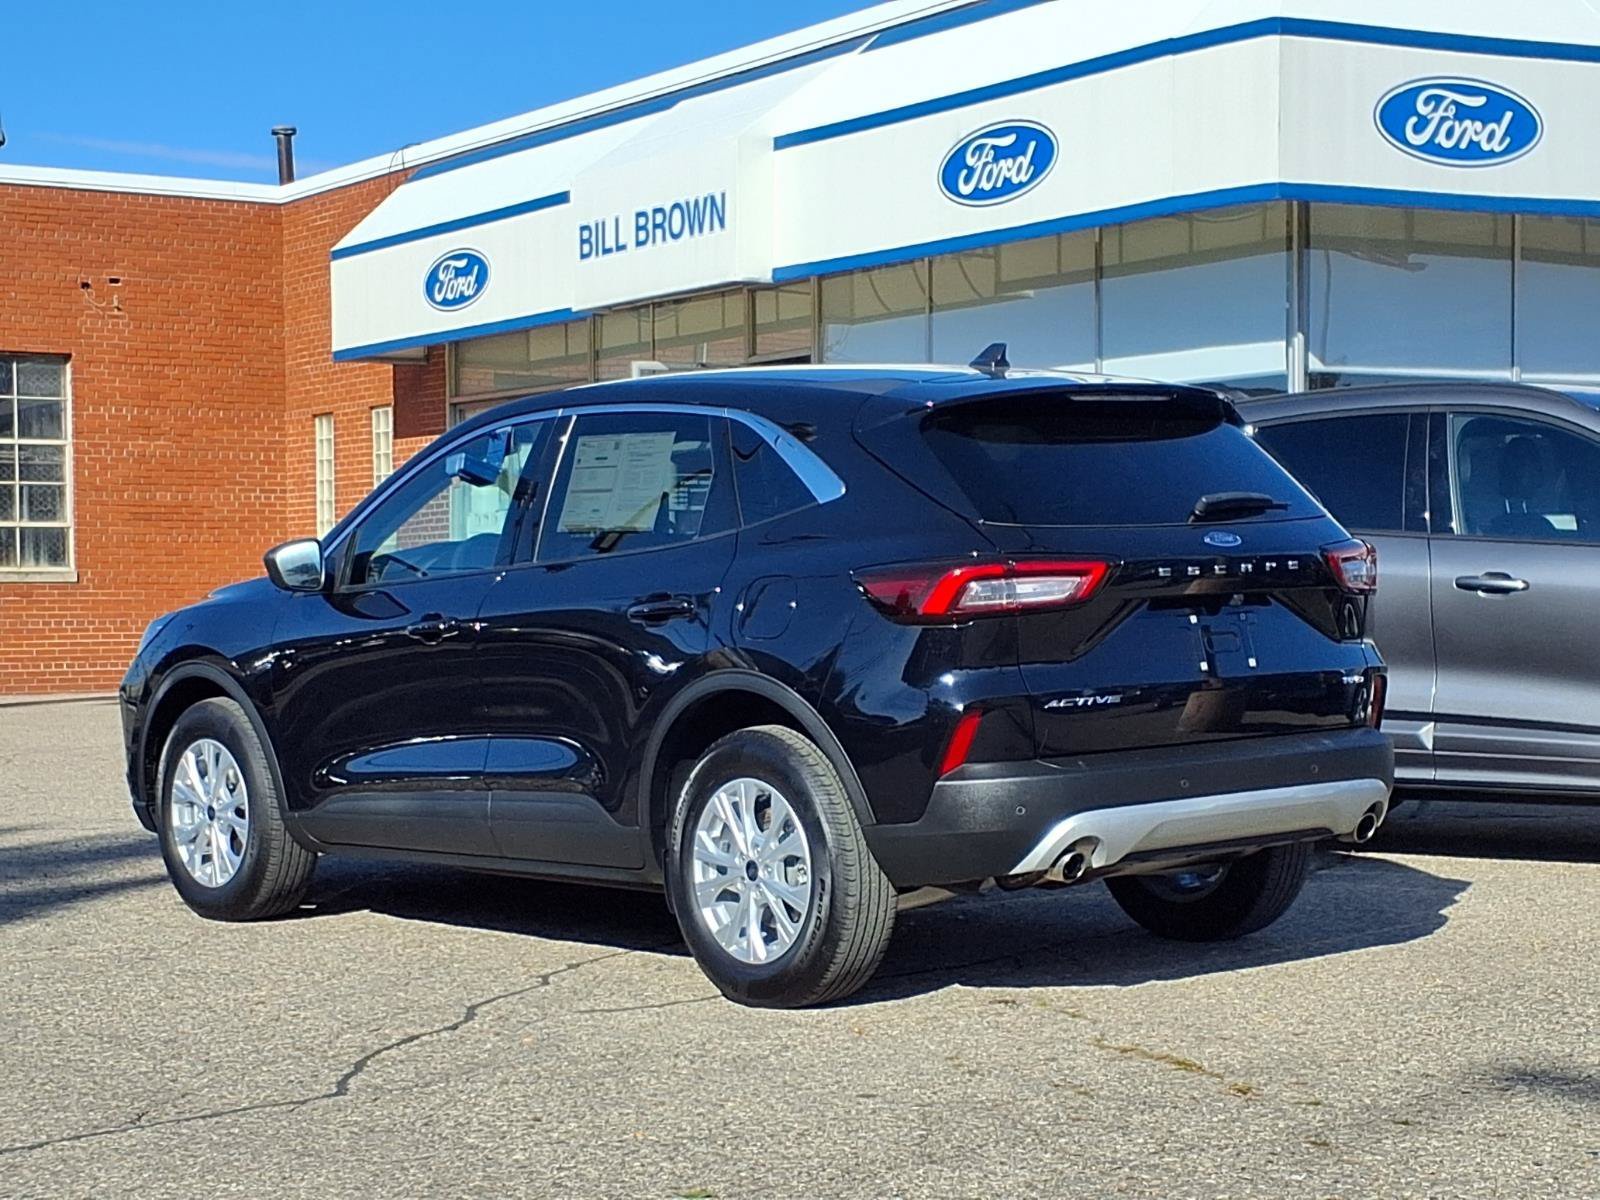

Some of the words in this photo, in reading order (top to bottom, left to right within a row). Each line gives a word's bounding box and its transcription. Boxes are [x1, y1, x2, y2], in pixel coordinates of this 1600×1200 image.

[1404, 88, 1514, 153] Ford
[957, 132, 1037, 196] Ford
[579, 215, 628, 261] BILL
[634, 191, 726, 248] BROWN
[434, 258, 479, 302] Ford
[1043, 694, 1123, 709] ACTIVE
